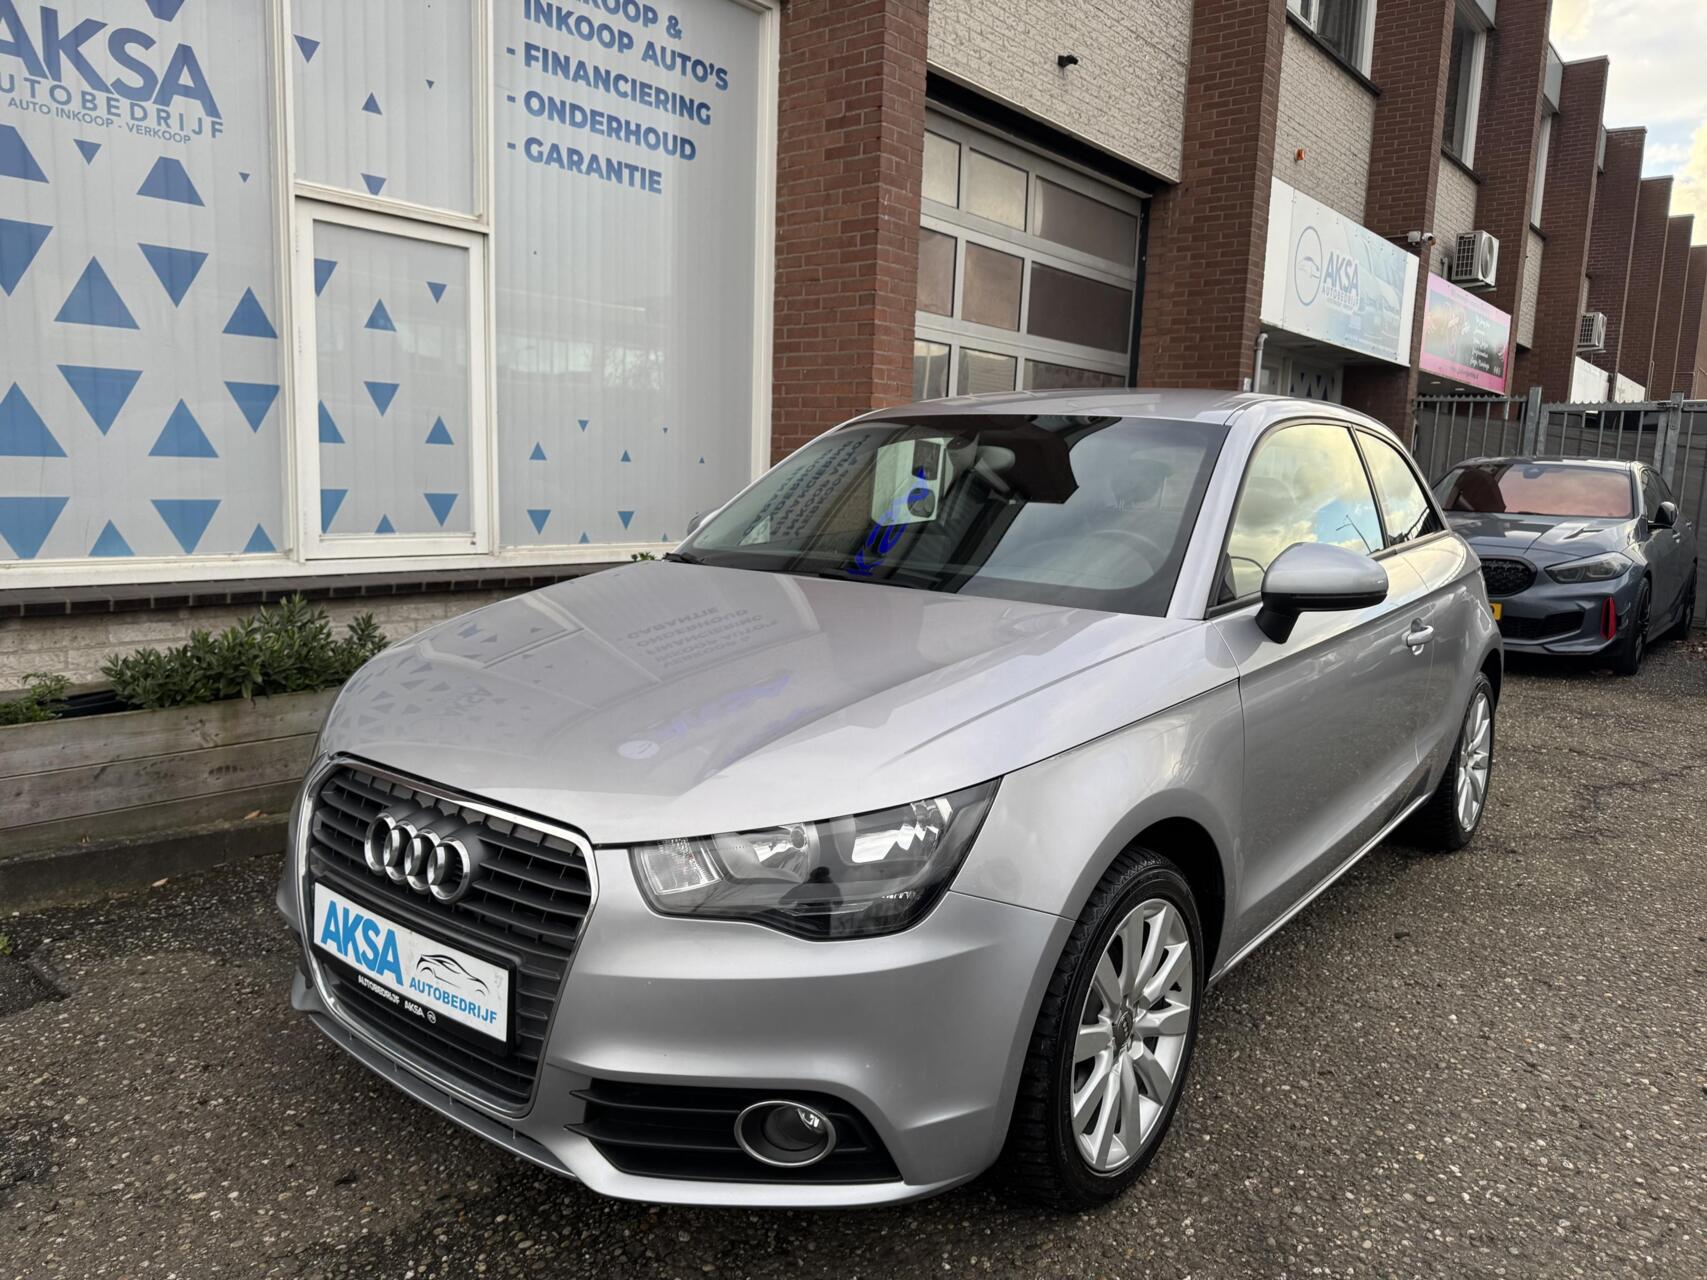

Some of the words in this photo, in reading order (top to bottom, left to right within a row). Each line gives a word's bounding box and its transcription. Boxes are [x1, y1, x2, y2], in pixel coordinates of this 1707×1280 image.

[524, 0, 634, 53] INKOOP
[641, 41, 729, 91] AUTO'S
[666, 15, 682, 40] &
[0, 0, 222, 120] AKSA
[524, 42, 712, 126] FINANCIERING
[8, 97, 51, 115] AUTO
[55, 107, 114, 128] INKOOP
[126, 122, 191, 144] VERKOOP
[524, 90, 696, 161] ONDERHOUD
[524, 137, 662, 194] GARANTIE
[1323, 250, 1359, 297] AKSA
[321, 900, 404, 986] AKSA
[404, 1000, 426, 1018] AKSA
[409, 976, 497, 1024] AUTOBEDRIJF
